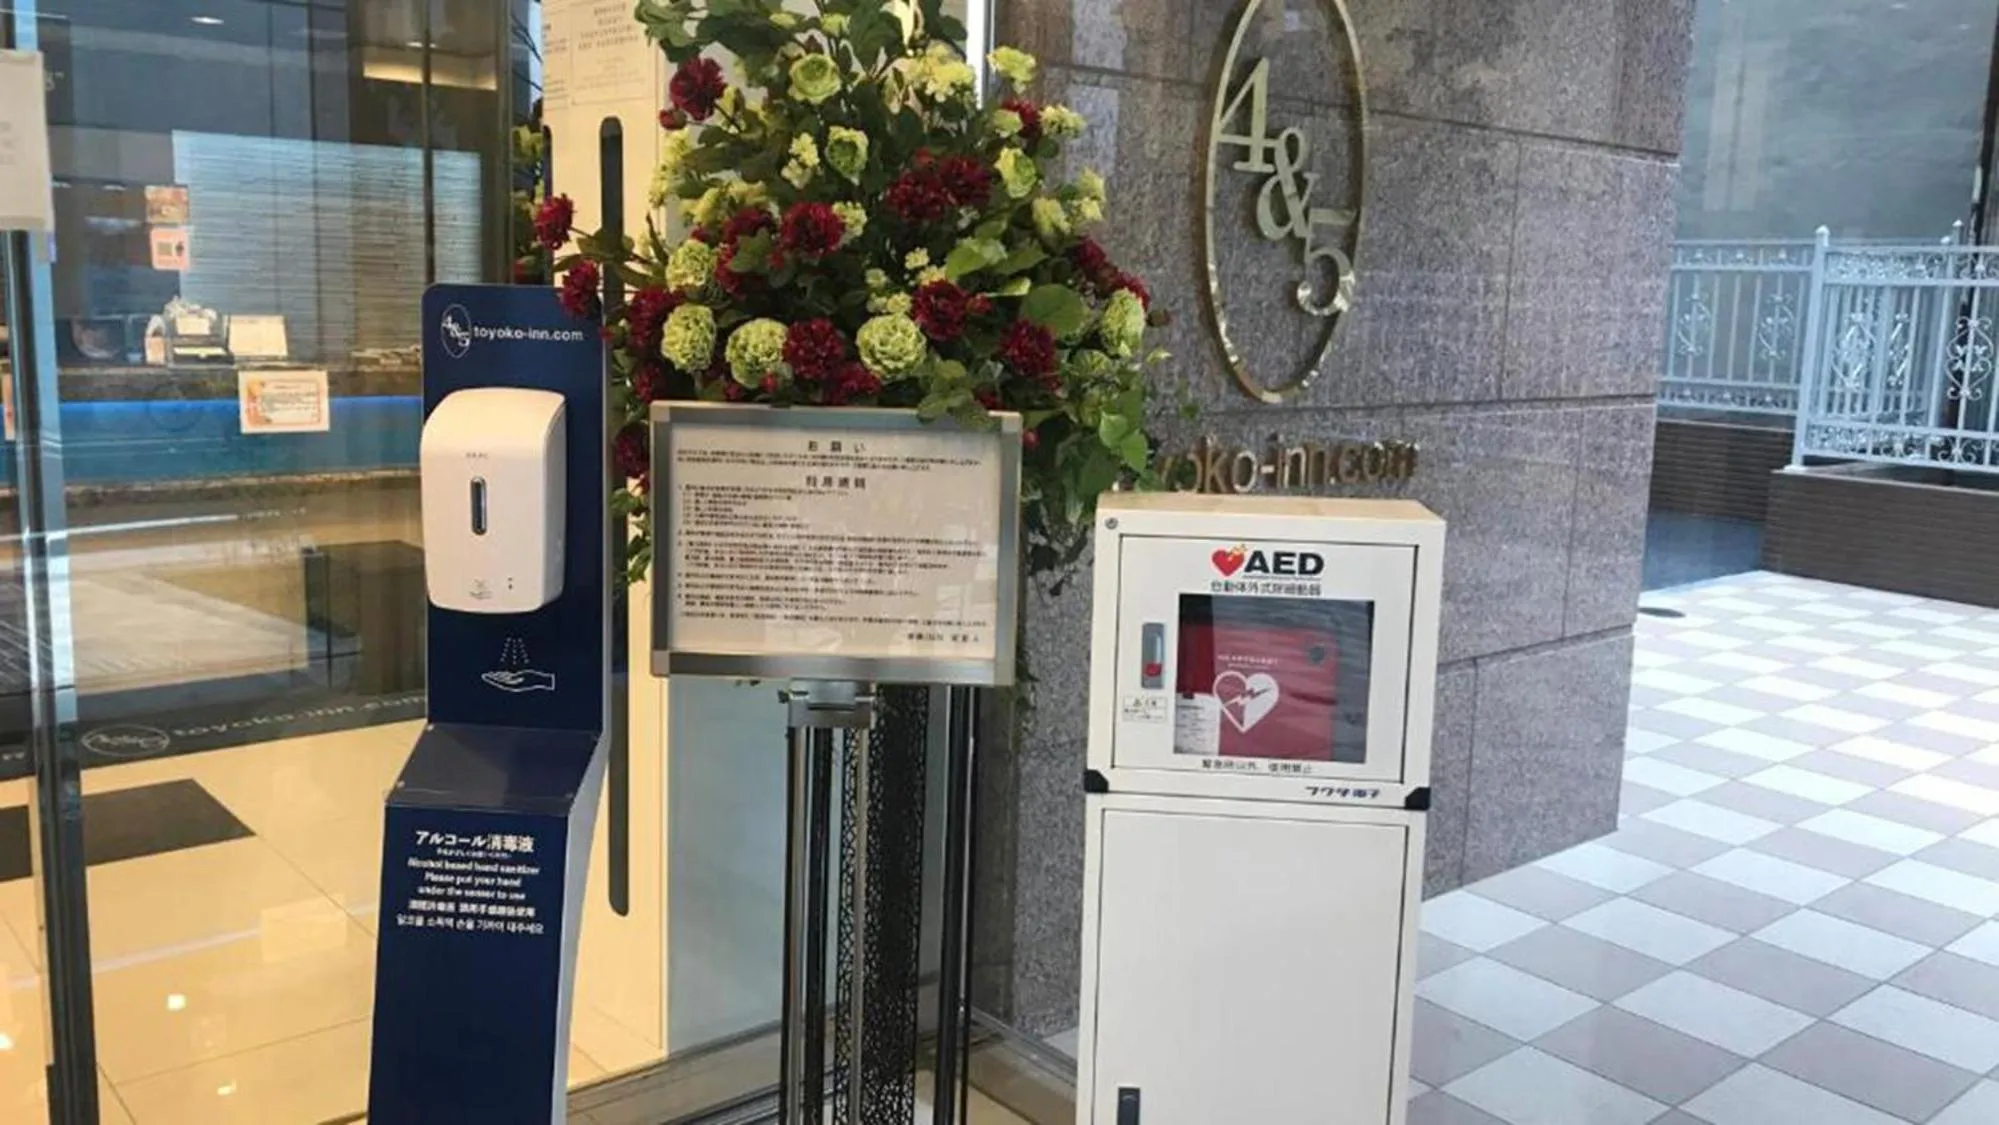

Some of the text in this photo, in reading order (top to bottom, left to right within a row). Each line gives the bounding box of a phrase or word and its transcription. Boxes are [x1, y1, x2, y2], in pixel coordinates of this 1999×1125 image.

[474, 325, 584, 341] toyoko-inn.com
[1244, 550, 1325, 575] AED
[415, 831, 534, 853] アルコール消毒液
[445, 859, 473, 871] based
[474, 861, 499, 873] hand
[499, 863, 540, 875] sanitizer
[424, 871, 521, 888] Please put your hand
[417, 884, 526, 900] under the sensor to use
